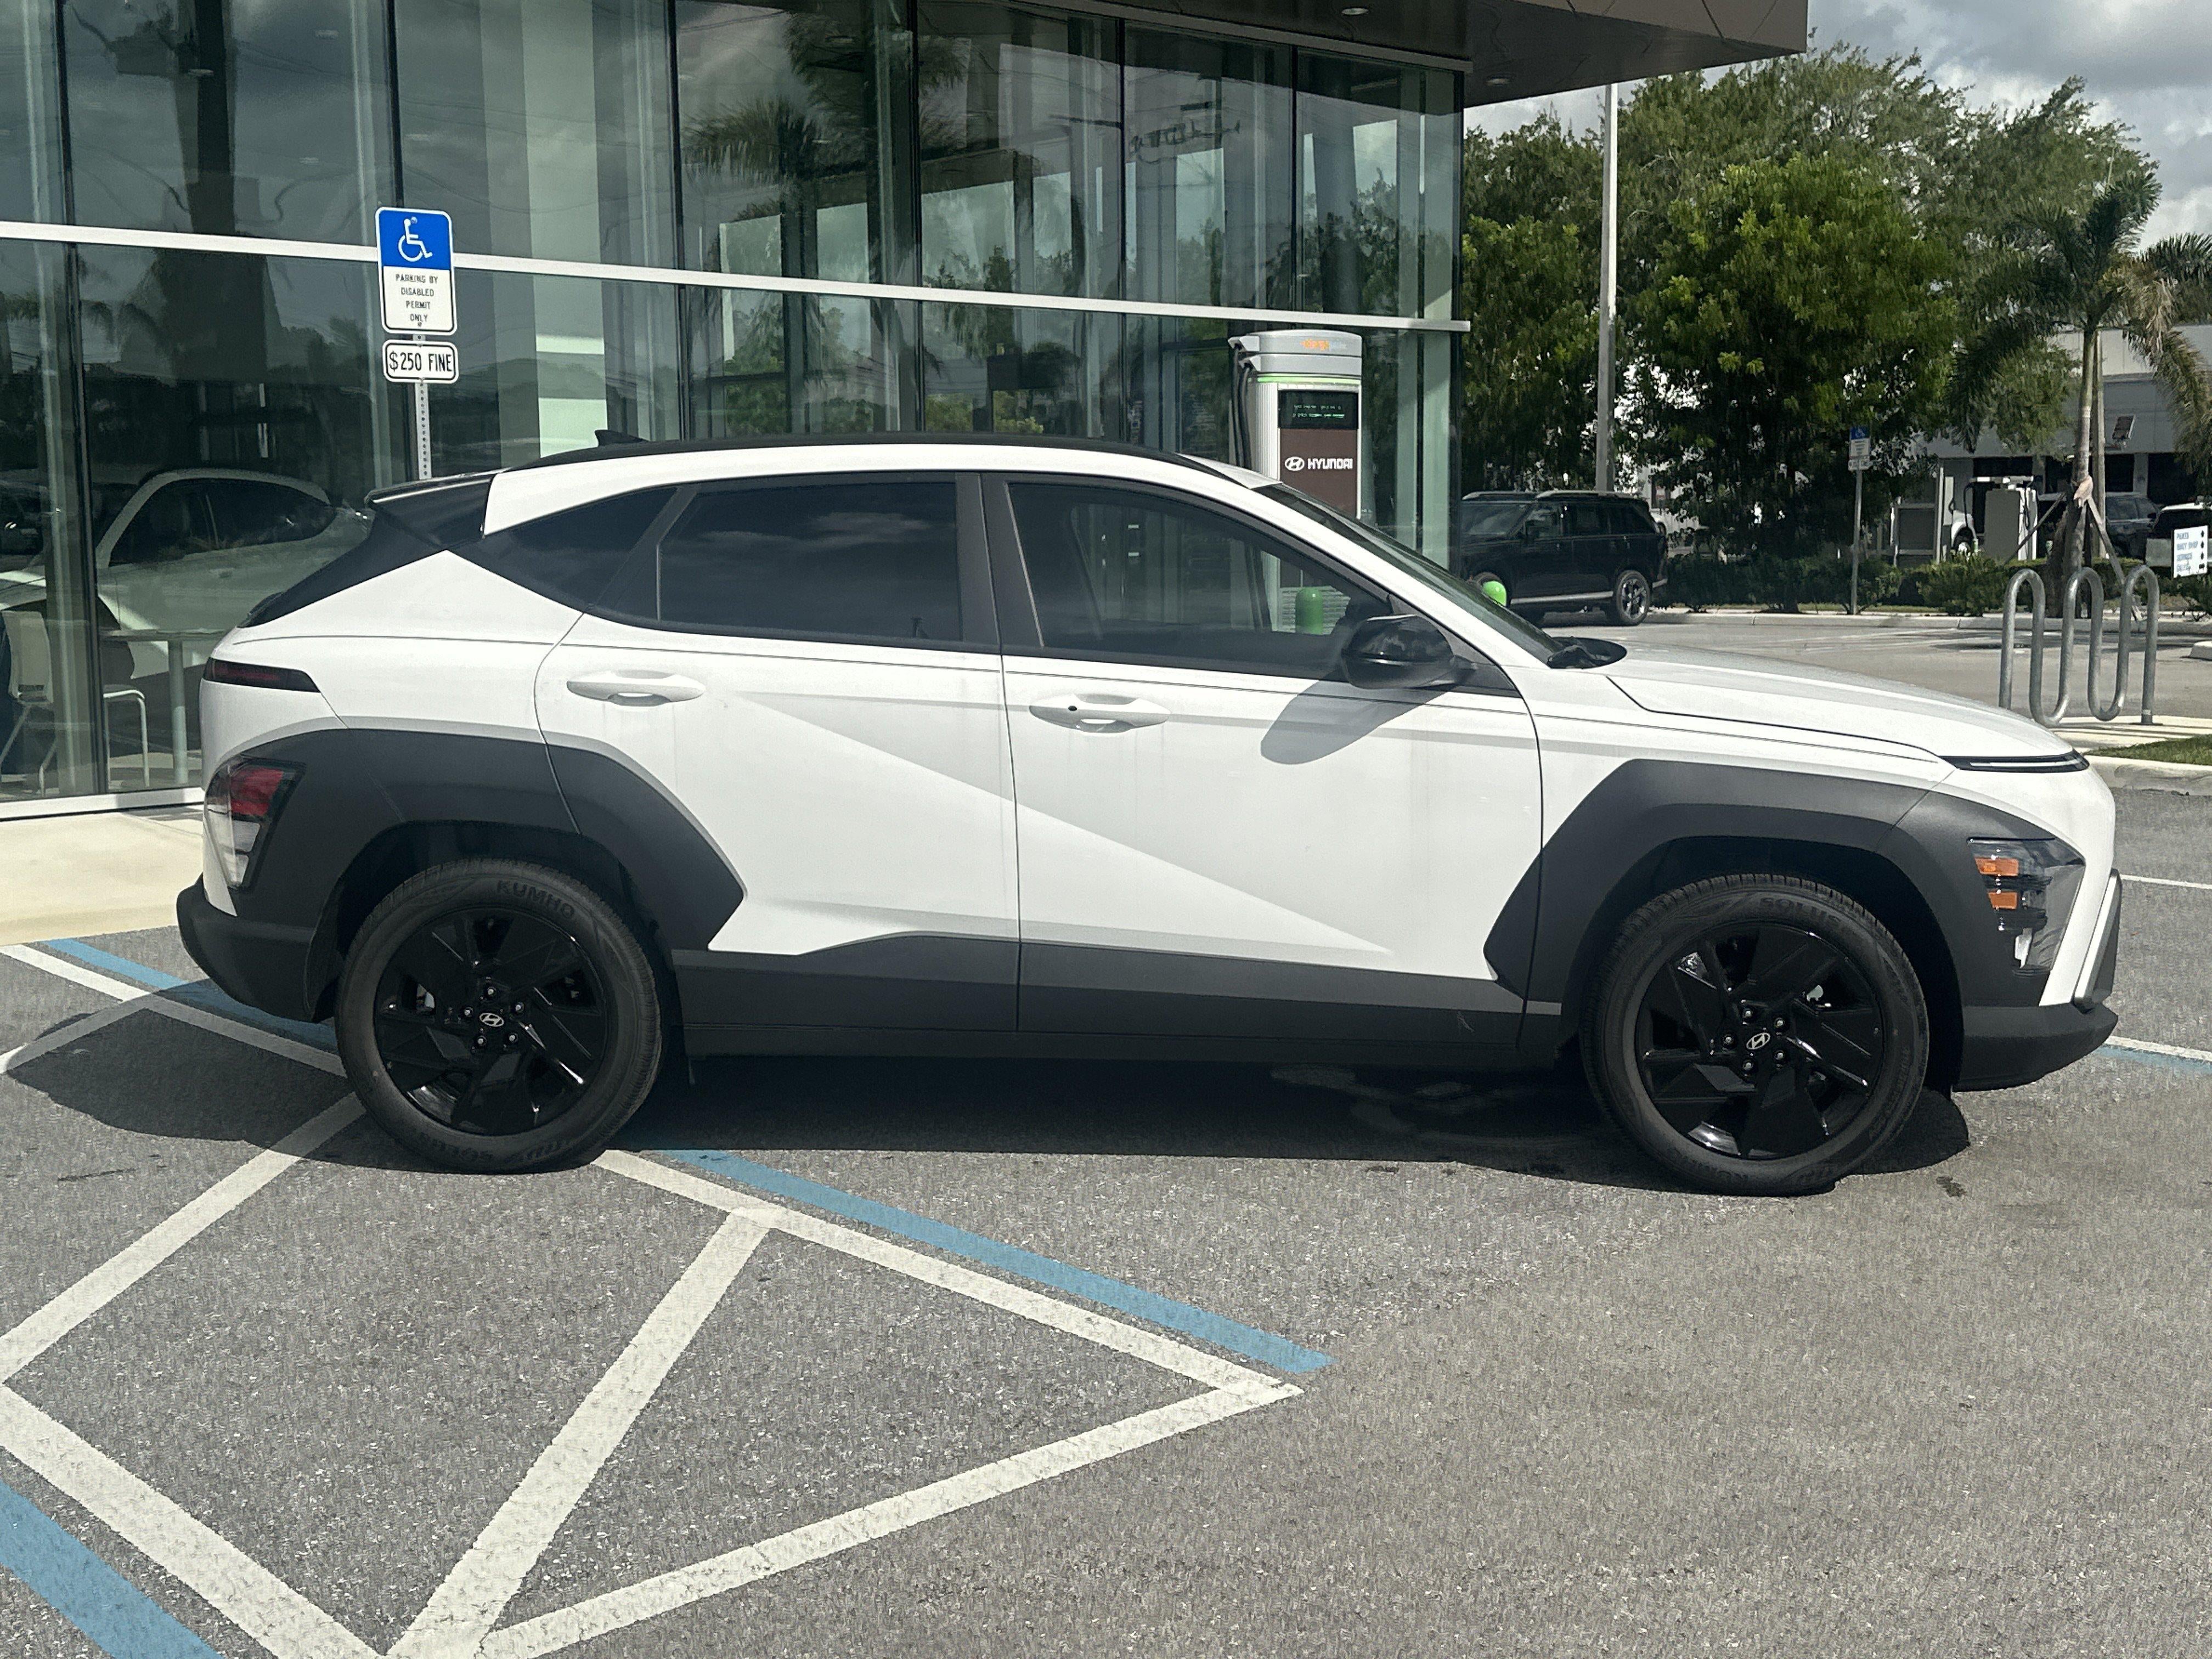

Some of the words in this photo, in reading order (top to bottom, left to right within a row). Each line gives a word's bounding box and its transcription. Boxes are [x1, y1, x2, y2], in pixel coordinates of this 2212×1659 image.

[395, 273, 426, 283] PARKING
[429, 275, 438, 284] BY
[400, 287, 435, 297] DISABLED
[405, 300, 431, 309] PERMIT
[410, 313, 428, 322] ONLY
[389, 351, 421, 372] $250
[428, 353, 453, 372] FINE
[1307, 458, 1353, 470] HYUNDAI
[496, 880, 574, 918] KUMHO
